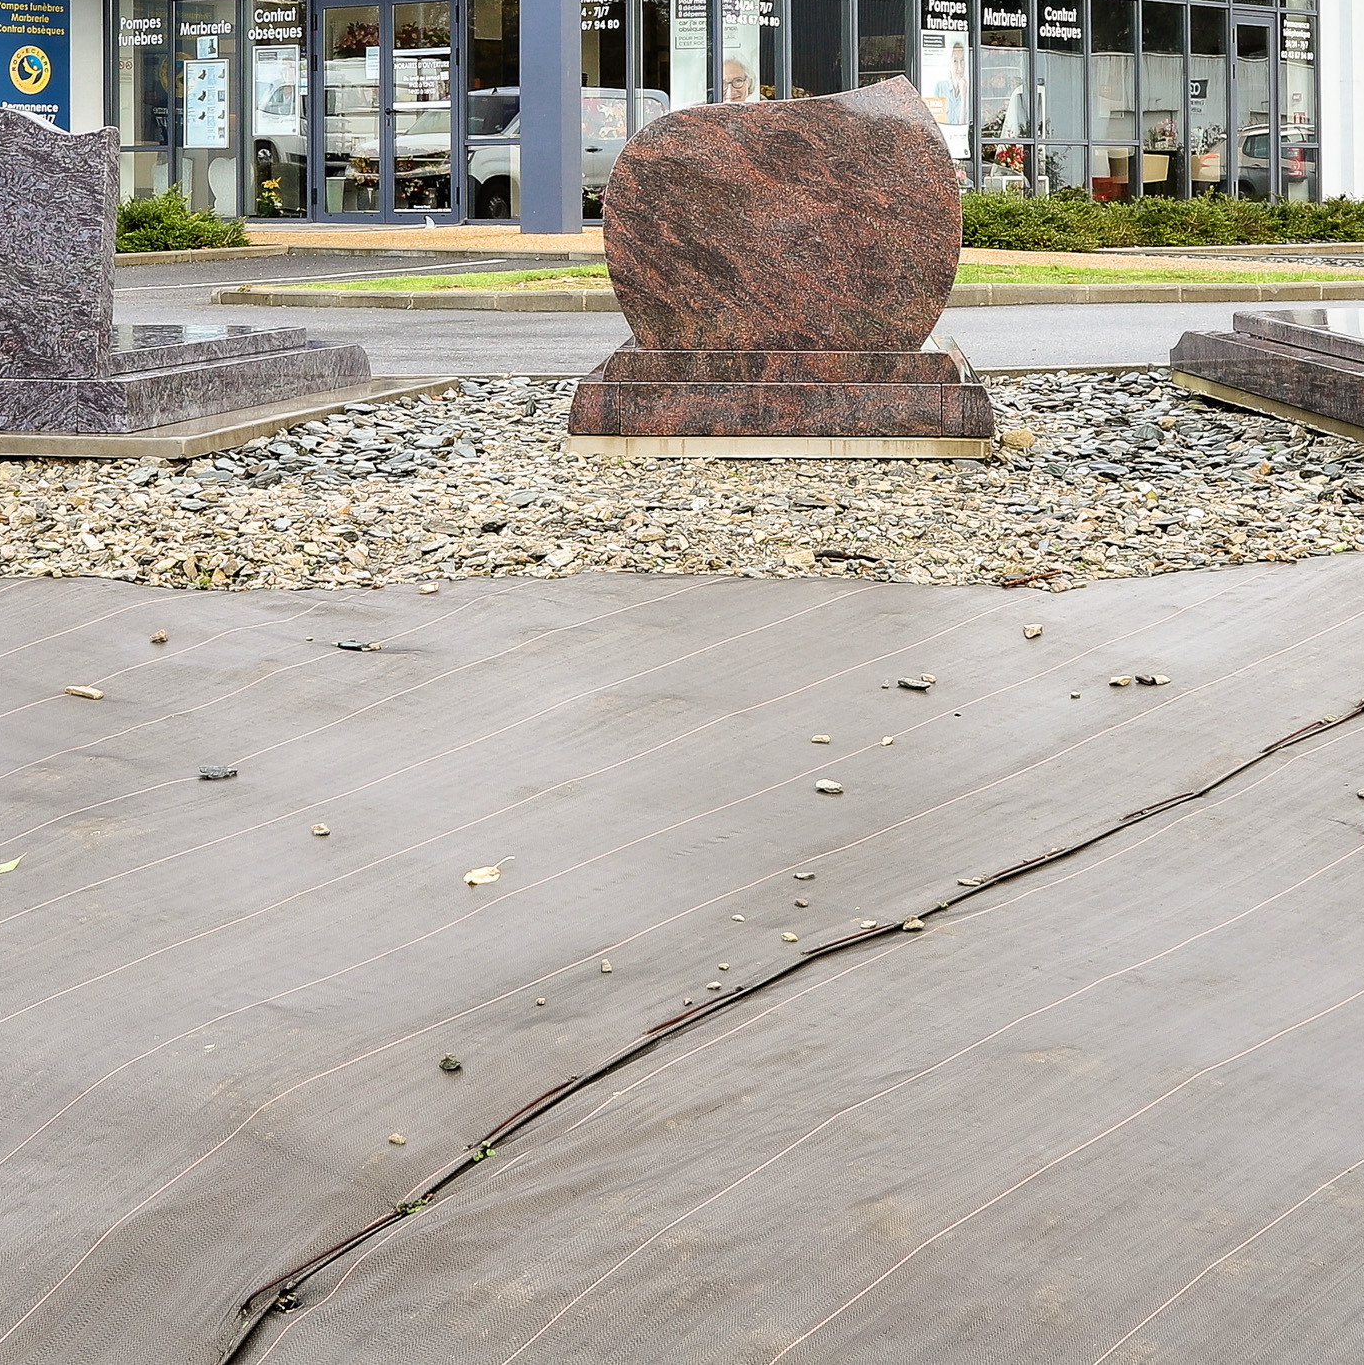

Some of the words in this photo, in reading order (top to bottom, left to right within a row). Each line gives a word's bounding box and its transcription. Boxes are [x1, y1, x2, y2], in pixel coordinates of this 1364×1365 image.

[29, 2, 64, 13] funèbres
[581, 7, 587, 16] 4
[735, 0, 754, 11] 24/24
[11, 13, 50, 23] Marbrerie
[254, 7, 296, 23] Contrat
[726, 14, 737, 24] 02
[737, 15, 747, 25] 43
[748, 16, 758, 25] 67
[759, 16, 769, 26] 94
[769, 17, 780, 27] 80
[983, 8, 1028, 28] Marbrerie
[1044, 7, 1077, 22] Contrat
[120, 17, 162, 32] Pompes
[180, 20, 232, 36] Marbrerie
[581, 21, 593, 30] 67
[594, 20, 606, 29] 94
[607, 19, 620, 29] 80
[927, 14, 968, 31] funèbres
[26, 25, 65, 36] obsèques
[248, 25, 303, 43] obsèques
[1039, 22, 1082, 41] obsèques
[118, 32, 163, 47] funèbres
